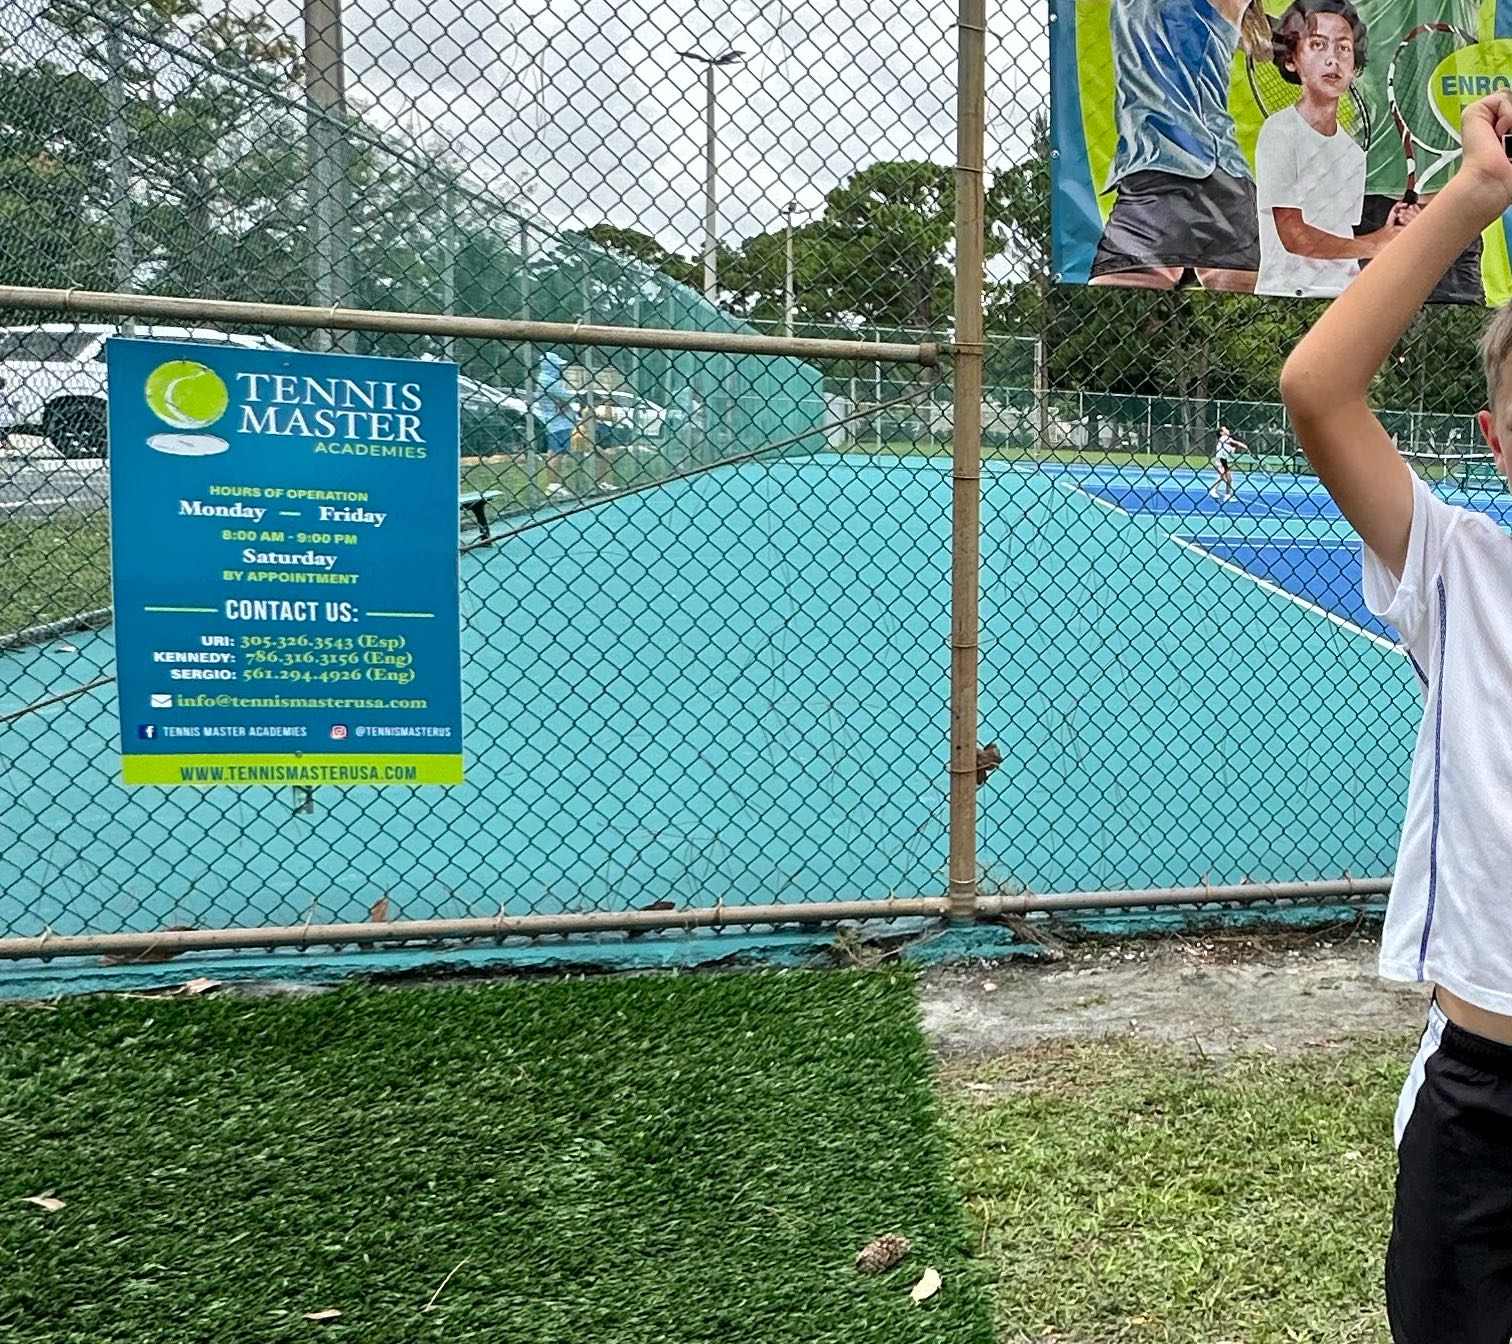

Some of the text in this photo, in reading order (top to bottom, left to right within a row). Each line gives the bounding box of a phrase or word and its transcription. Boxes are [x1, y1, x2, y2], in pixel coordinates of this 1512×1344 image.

[235, 372, 422, 412] TENNIS
[236, 404, 427, 443] MASTER
[314, 441, 427, 459] ACADEMIES
[209, 485, 369, 502] HOURS OF OPERATION
[178, 499, 268, 523] Monday
[318, 506, 388, 528] Friday
[221, 529, 257, 541] 8:00
[260, 531, 285, 542] AM
[296, 532, 331, 544] 9:00
[334, 534, 358, 545] PM
[242, 548, 338, 570] Saturday
[223, 571, 360, 584] BY APPOINTMENT
[225, 599, 360, 623] CONTACT US:
[201, 635, 406, 652] URI: 305.326.3543 (Esp)
[153, 650, 413, 667] KENNEDY: 786.316.3156 (Eng)
[170, 668, 416, 684] SERGIO: 561.294.4926 (Eng)
[177, 693, 428, 709] info@tennismasterusa.com
[163, 726, 200, 737] TENNIS
[203, 726, 246, 737] MASTER
[248, 726, 308, 737] ACADEMIES
[355, 726, 452, 738] @TENNISMASTERUS
[180, 765, 417, 782] WWW.TENNISMASTERUSA.COM
